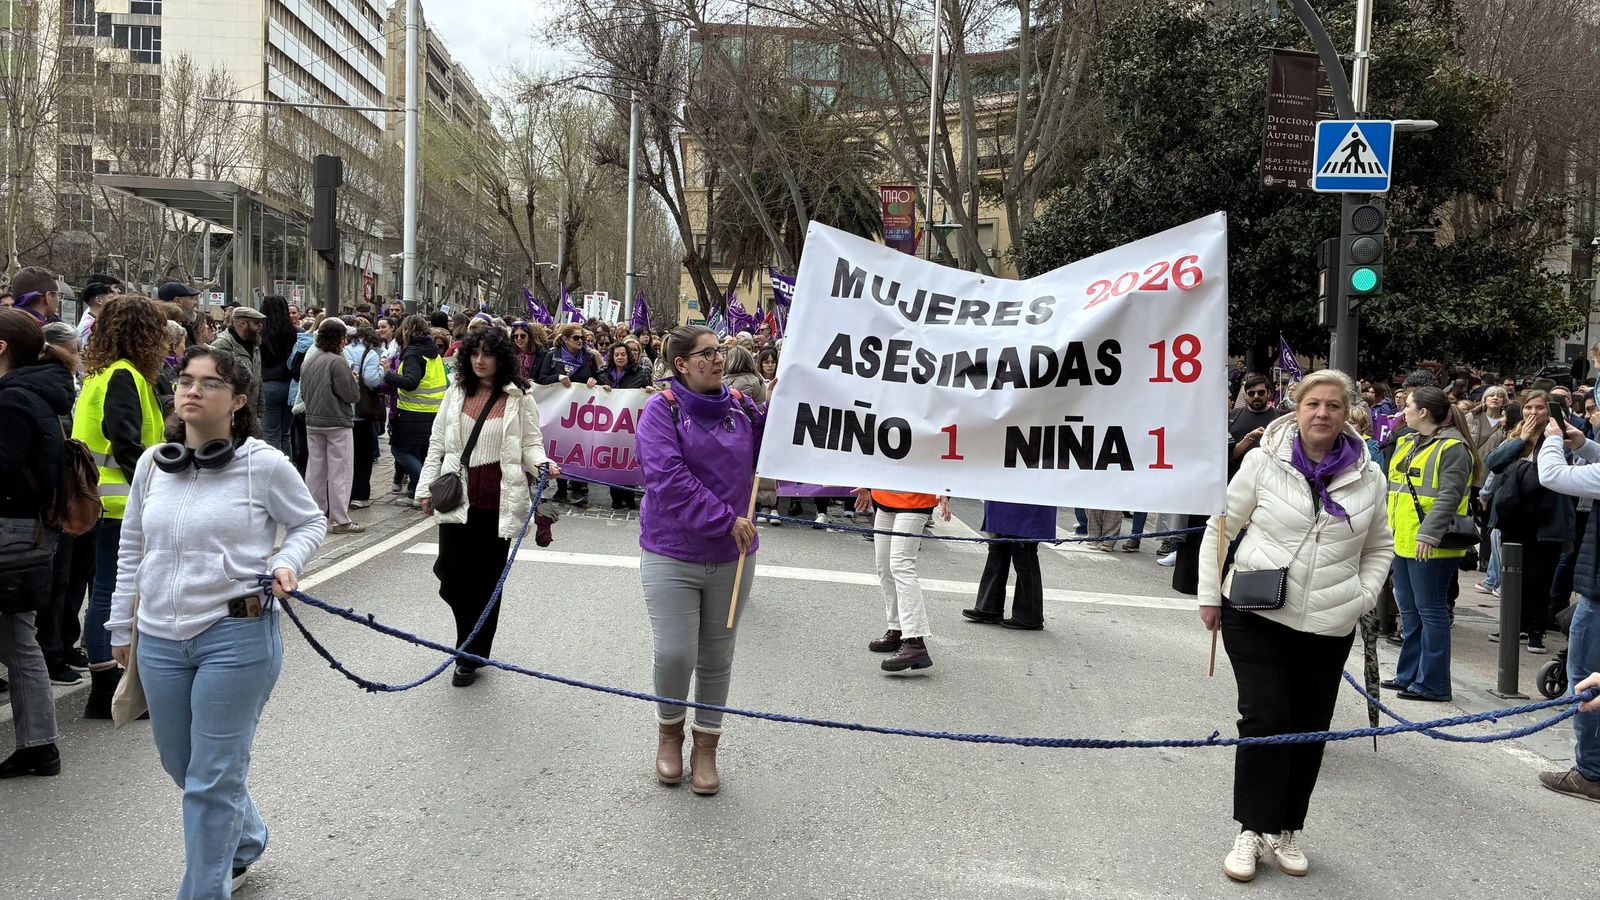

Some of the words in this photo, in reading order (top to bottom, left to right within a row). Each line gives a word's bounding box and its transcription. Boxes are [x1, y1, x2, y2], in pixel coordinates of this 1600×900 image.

[1265, 140, 1303, 149] (1726-2026)
[1264, 165, 1314, 174] MAGISTERI
[882, 189, 911, 203] MAO
[830, 256, 1057, 326] MUJERES
[1082, 253, 1204, 311] 2026
[817, 332, 1122, 391] ASESINADAS
[1148, 333, 1203, 384] 18
[791, 399, 912, 460] NIÑO
[940, 423, 965, 460] 1
[1004, 415, 1134, 471] NIÑA
[1148, 426, 1174, 470] 1
[548, 440, 587, 467] LA
